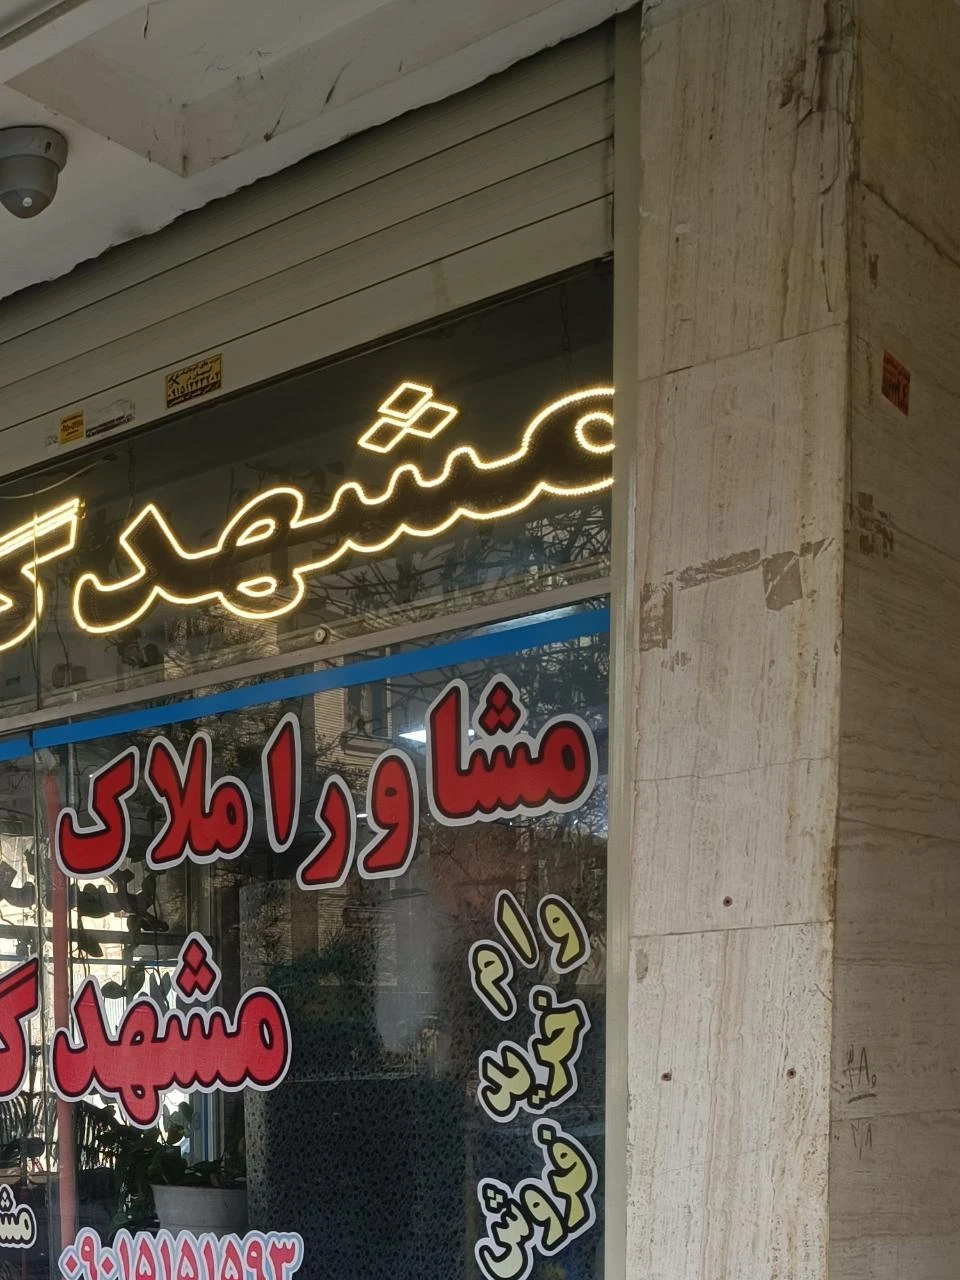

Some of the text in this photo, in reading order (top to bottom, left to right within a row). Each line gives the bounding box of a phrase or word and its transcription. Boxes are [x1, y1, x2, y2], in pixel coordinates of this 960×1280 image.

[74, 383, 614, 633] مشهد
[56, 674, 597, 890] مشاور املاک
[50, 932, 291, 1128] مشهد
[470, 890, 589, 1020] وام
[478, 986, 589, 1122] خرید
